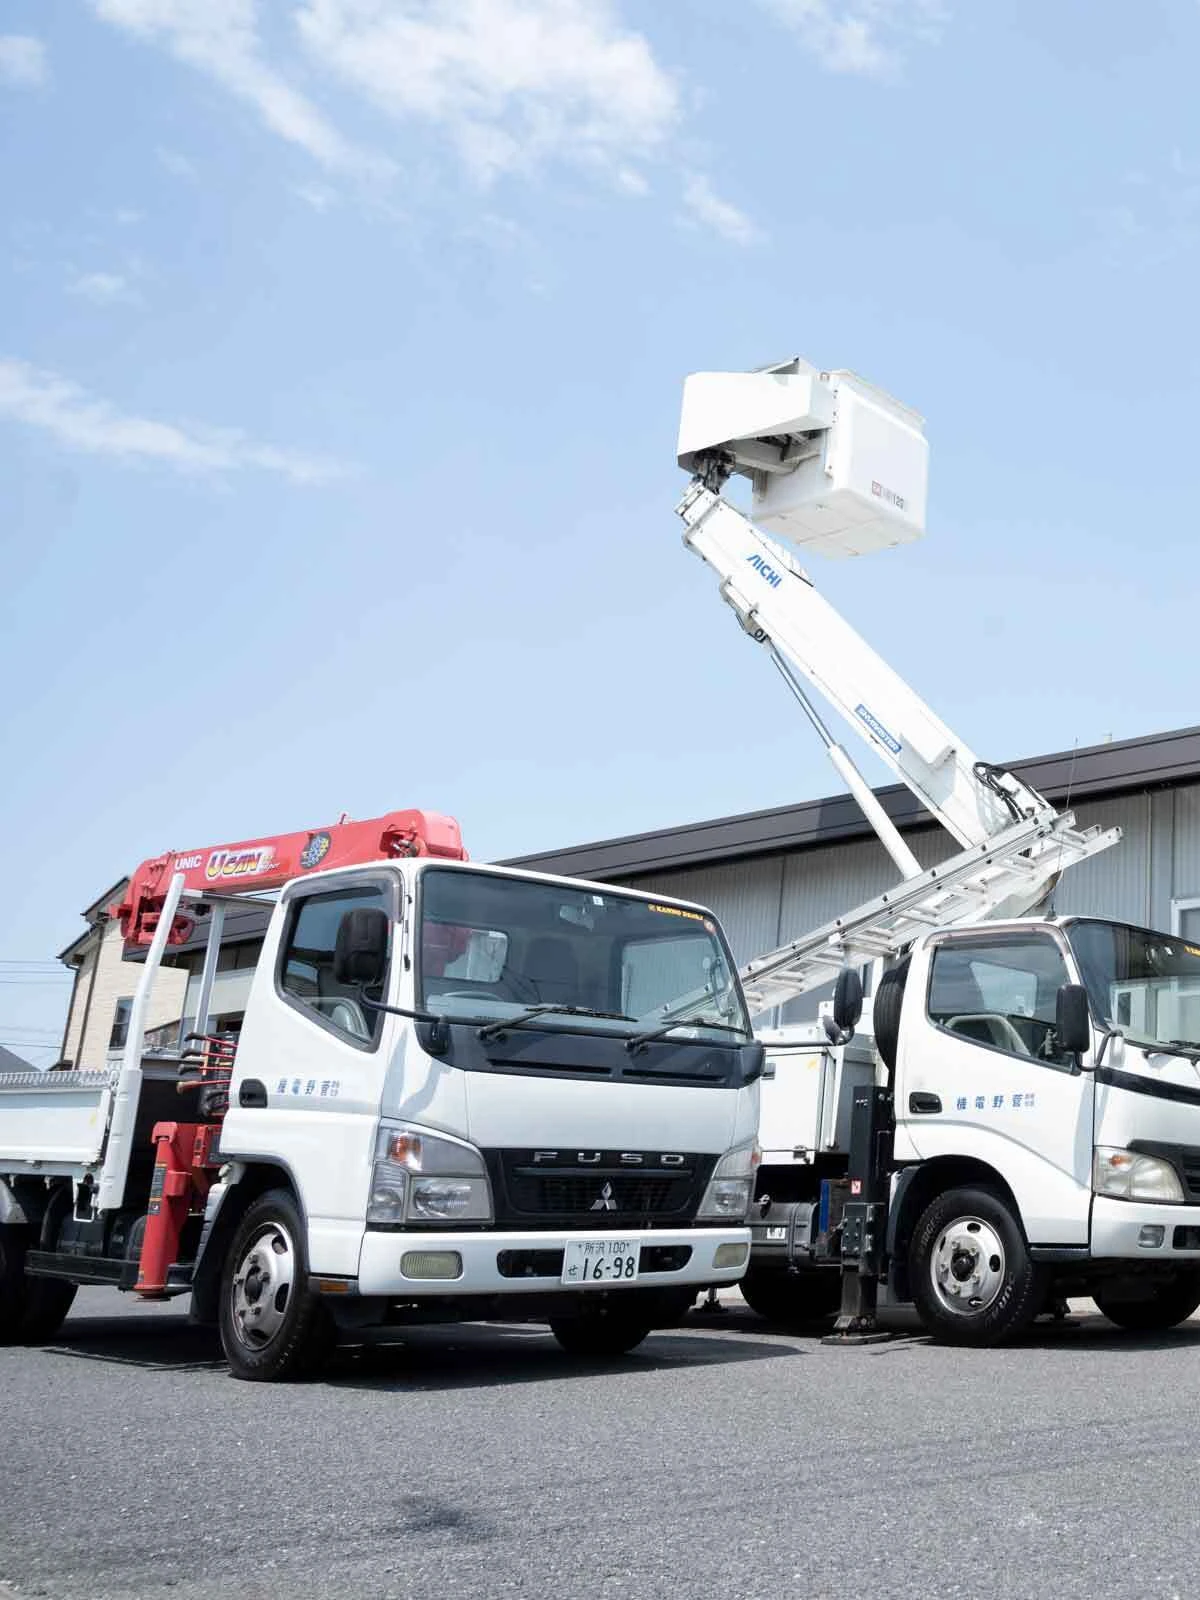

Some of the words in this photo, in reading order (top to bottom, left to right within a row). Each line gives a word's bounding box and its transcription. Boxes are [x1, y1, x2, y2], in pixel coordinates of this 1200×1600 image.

[746, 555, 782, 588] AICHI
[175, 855, 202, 870] UNIC
[533, 1151, 685, 1165] FUSO
[583, 1256, 635, 1281] 16-98
